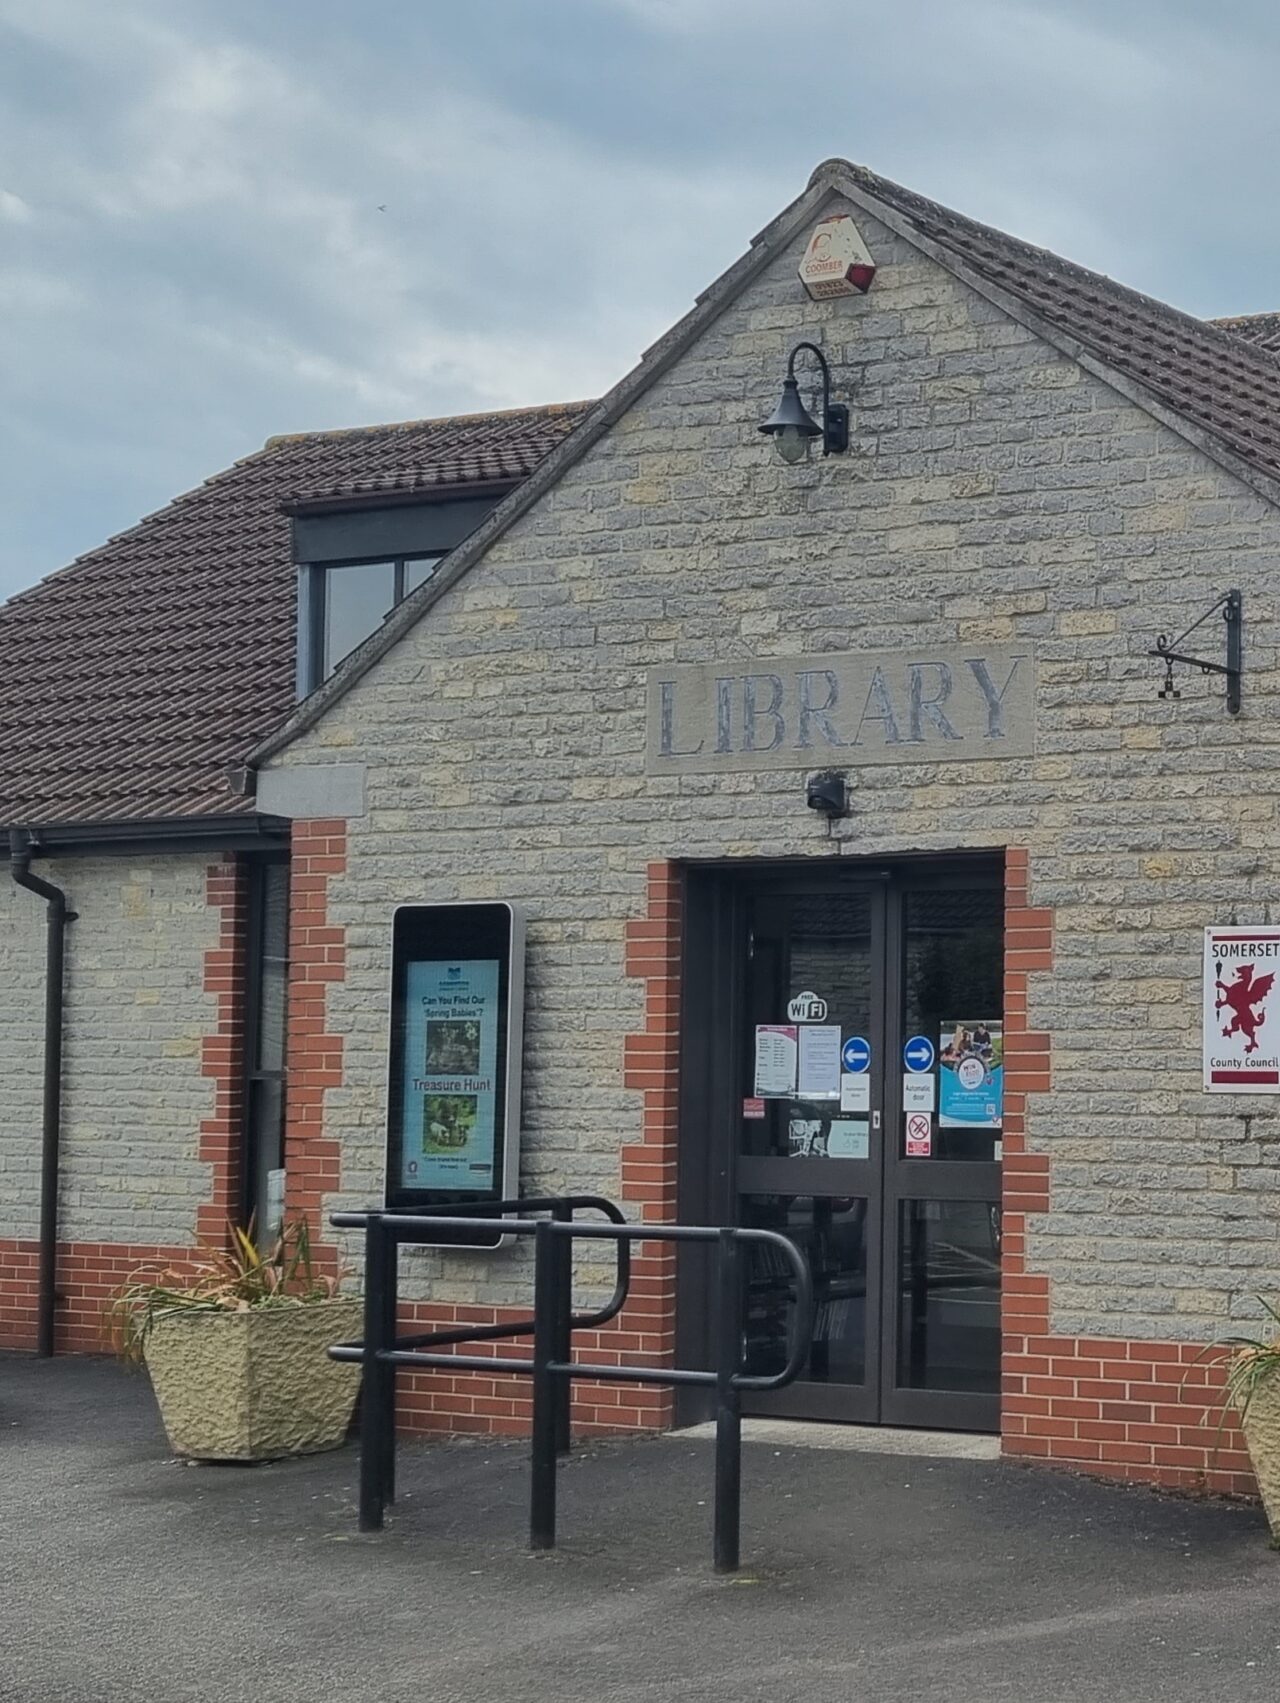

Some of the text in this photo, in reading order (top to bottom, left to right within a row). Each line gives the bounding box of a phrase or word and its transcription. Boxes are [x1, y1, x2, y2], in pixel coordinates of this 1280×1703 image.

[658, 655, 1028, 756] LIBRARY
[1212, 943, 1280, 957] SOMERSET
[422, 995, 485, 1005] Can You Find Our
[1210, 1057, 1279, 1069] County Council
[413, 1078, 491, 1091] Treasure Hunt
